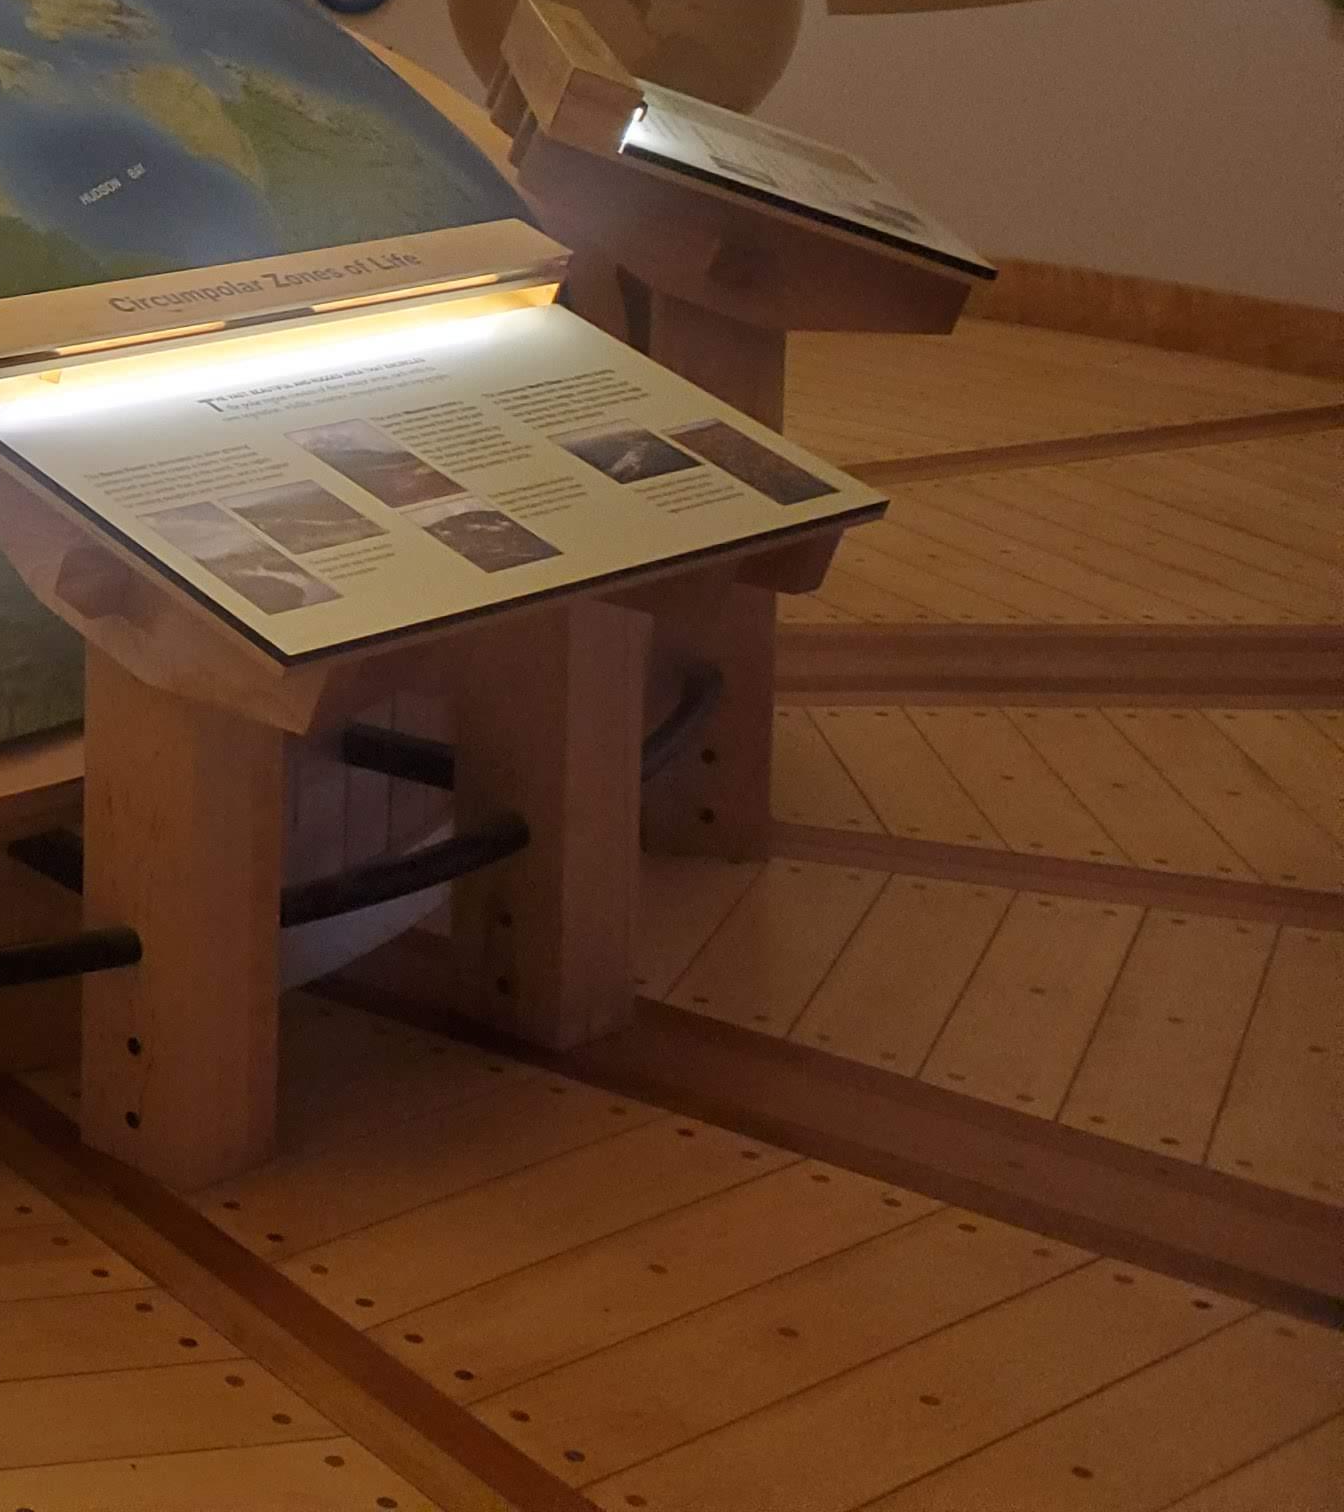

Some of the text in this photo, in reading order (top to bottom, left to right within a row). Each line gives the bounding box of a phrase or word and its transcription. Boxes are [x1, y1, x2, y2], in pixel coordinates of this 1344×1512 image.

[78, 162, 145, 206] HUDSON BAY
[109, 251, 422, 313] Circumpolar Zones of Life
